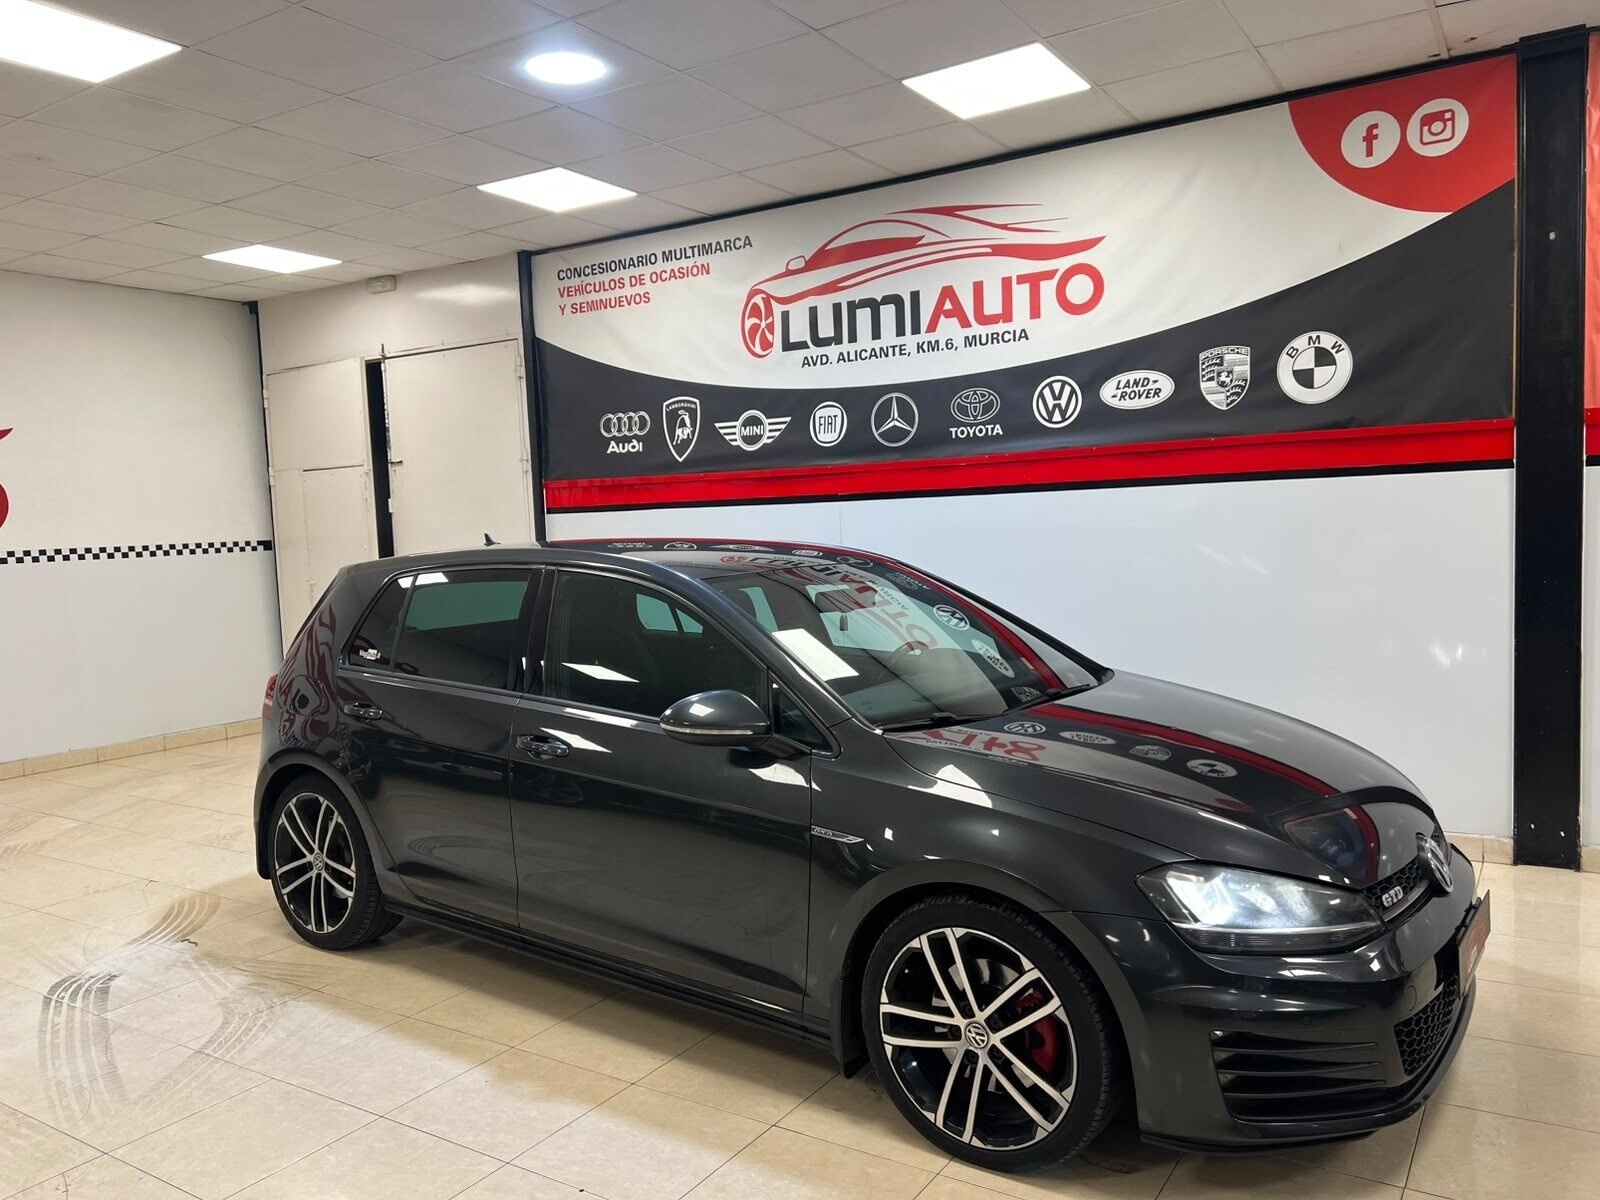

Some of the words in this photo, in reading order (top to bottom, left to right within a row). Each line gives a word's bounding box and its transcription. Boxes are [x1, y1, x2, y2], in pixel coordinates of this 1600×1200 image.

[557, 252, 658, 281] CONCESIONARIO
[661, 235, 753, 263] MULTIMARCA
[558, 276, 626, 299] VEHÍCULOS
[629, 273, 646, 288] DE
[650, 261, 711, 284] OCASIÓN
[558, 304, 567, 316] Y
[570, 291, 651, 315] SEMINUEVOS
[801, 352, 833, 369] AVD.
[836, 343, 912, 364] ALICANTE,
[963, 328, 1030, 348] MURCIA
[1201, 347, 1249, 360] PORSCHE
[740, 424, 764, 437] MINI
[817, 414, 839, 435] FIAT
[949, 423, 1003, 440] TOYOTA
[606, 438, 643, 454] Audi
[1381, 885, 1404, 908] GTD
